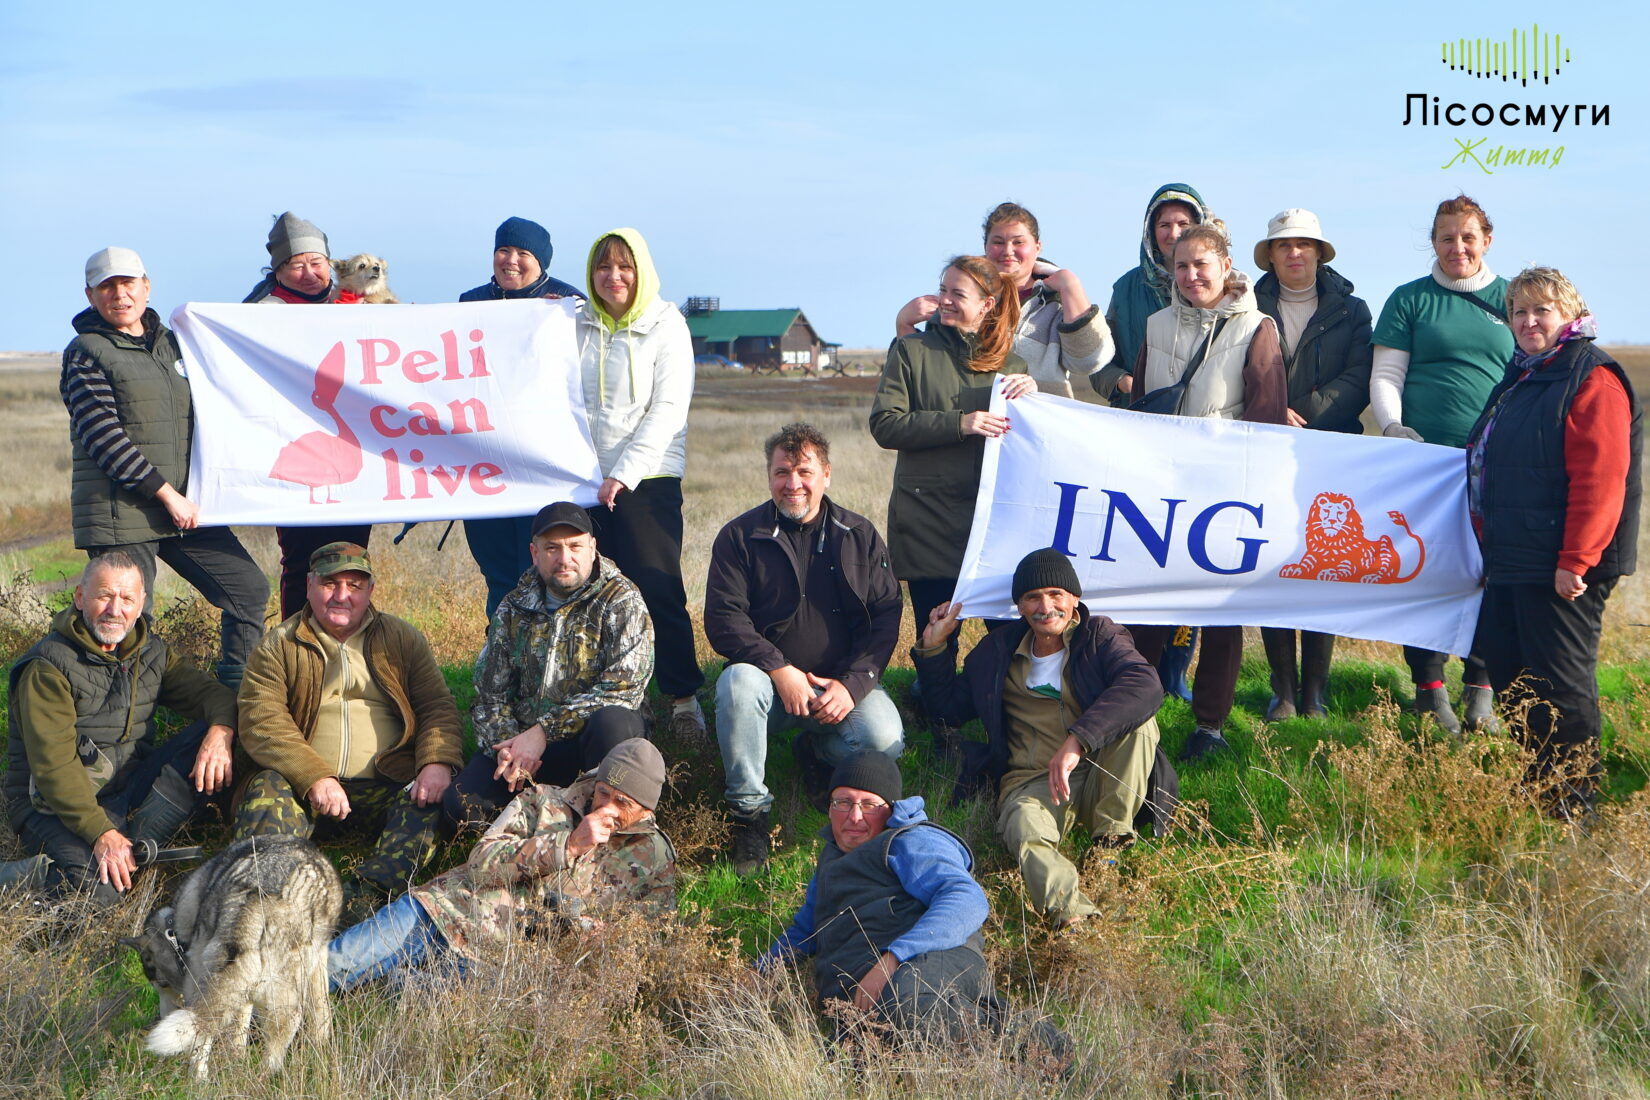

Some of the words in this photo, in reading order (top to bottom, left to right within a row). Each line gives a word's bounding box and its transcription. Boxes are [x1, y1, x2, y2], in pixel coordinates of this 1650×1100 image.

[357, 329, 491, 385] Peli
[369, 398, 494, 438] can
[382, 448, 507, 500] live
[1051, 481, 1269, 575] ING
